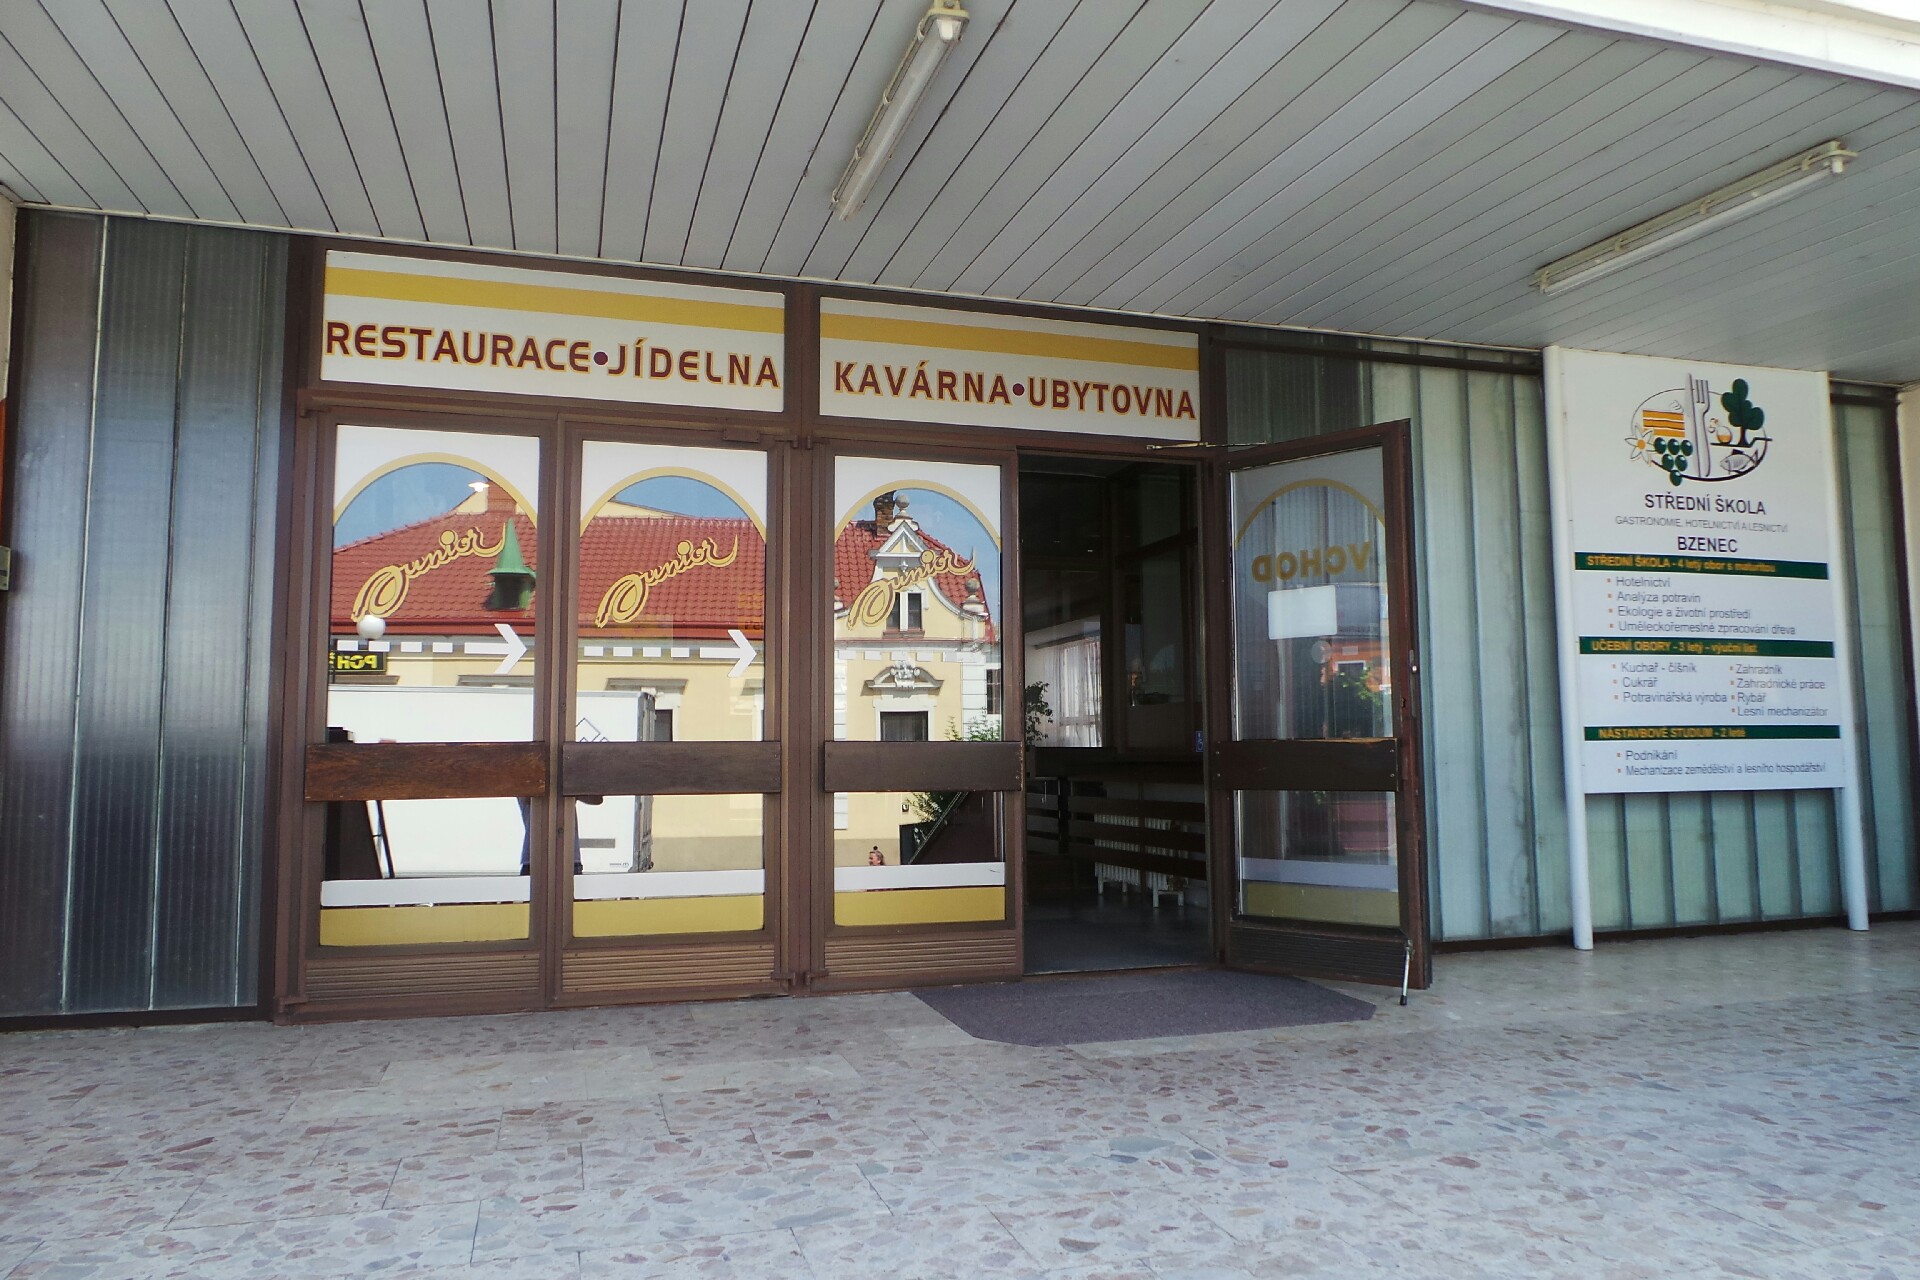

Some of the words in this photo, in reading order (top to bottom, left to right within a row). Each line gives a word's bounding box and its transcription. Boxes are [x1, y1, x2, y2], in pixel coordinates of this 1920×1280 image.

[325, 320, 591, 374] RESTAURACE
[607, 337, 781, 389] JÍDELNA
[834, 360, 1012, 406] KAVÁRNA
[1028, 376, 1197, 420] UBYTOVNA
[1645, 492, 1710, 511] STŘEDNÍ
[1716, 494, 1766, 514] ŠKOLA
[1678, 536, 1738, 552] BZENEC
[1635, 556, 1671, 568] ŠKOLA
[1616, 576, 1671, 588] Hotelnictví
[1617, 591, 1658, 604] Analýza
[1662, 593, 1701, 604] potravin
[1618, 606, 1663, 619] Ekologie
[1675, 607, 1706, 618] životní
[1710, 608, 1751, 620] prostředí
[1619, 621, 1715, 633] Uměleckořemeslné
[1718, 624, 1768, 635] zpracování
[1772, 624, 1796, 635] dřeva
[1621, 662, 1658, 673] Kuchař
[1668, 662, 1697, 673] číšník
[1736, 664, 1782, 674] Zahradník
[1622, 677, 1658, 688] Cukrář
[1737, 678, 1797, 689] Zahradnické
[1800, 680, 1826, 690] práce
[1623, 692, 1692, 702] Potravinářská
[1695, 692, 1728, 705] výroba
[1737, 706, 1764, 716] Lesní
[1768, 706, 1828, 716] mechanizátor
[1626, 750, 1678, 760] Podnikání
[1626, 765, 1682, 775] Mechanizace
